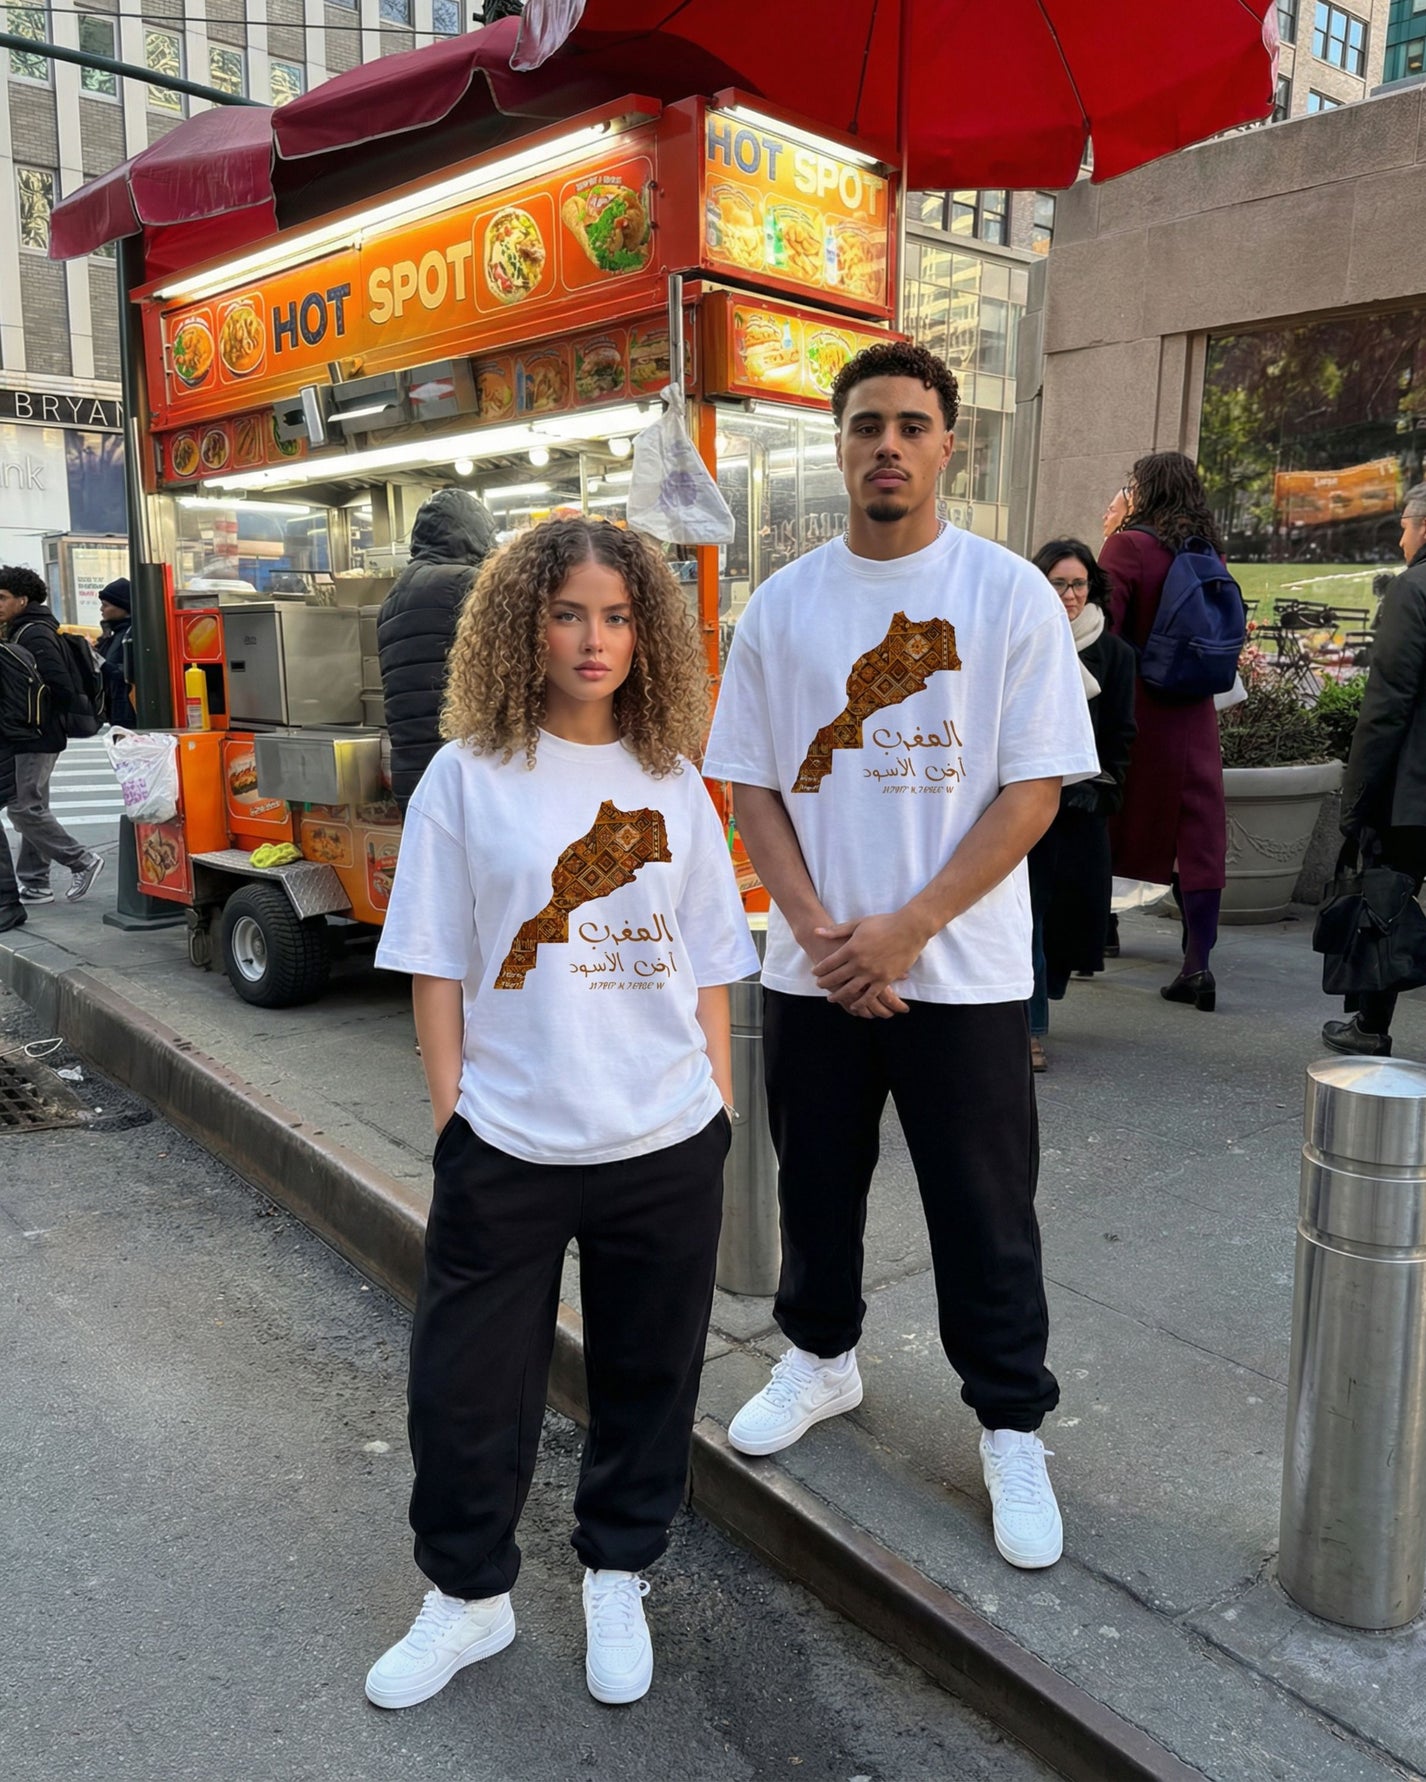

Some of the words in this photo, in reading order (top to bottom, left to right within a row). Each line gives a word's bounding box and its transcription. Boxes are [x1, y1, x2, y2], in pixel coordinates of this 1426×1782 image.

[707, 118, 783, 182] HOT
[793, 149, 883, 217] SPOT
[272, 282, 351, 354] HOT
[368, 240, 472, 325] SPOT
[0, 455, 46, 491] nk
[871, 719, 964, 756] المغرب
[577, 912, 674, 951] المغرب
